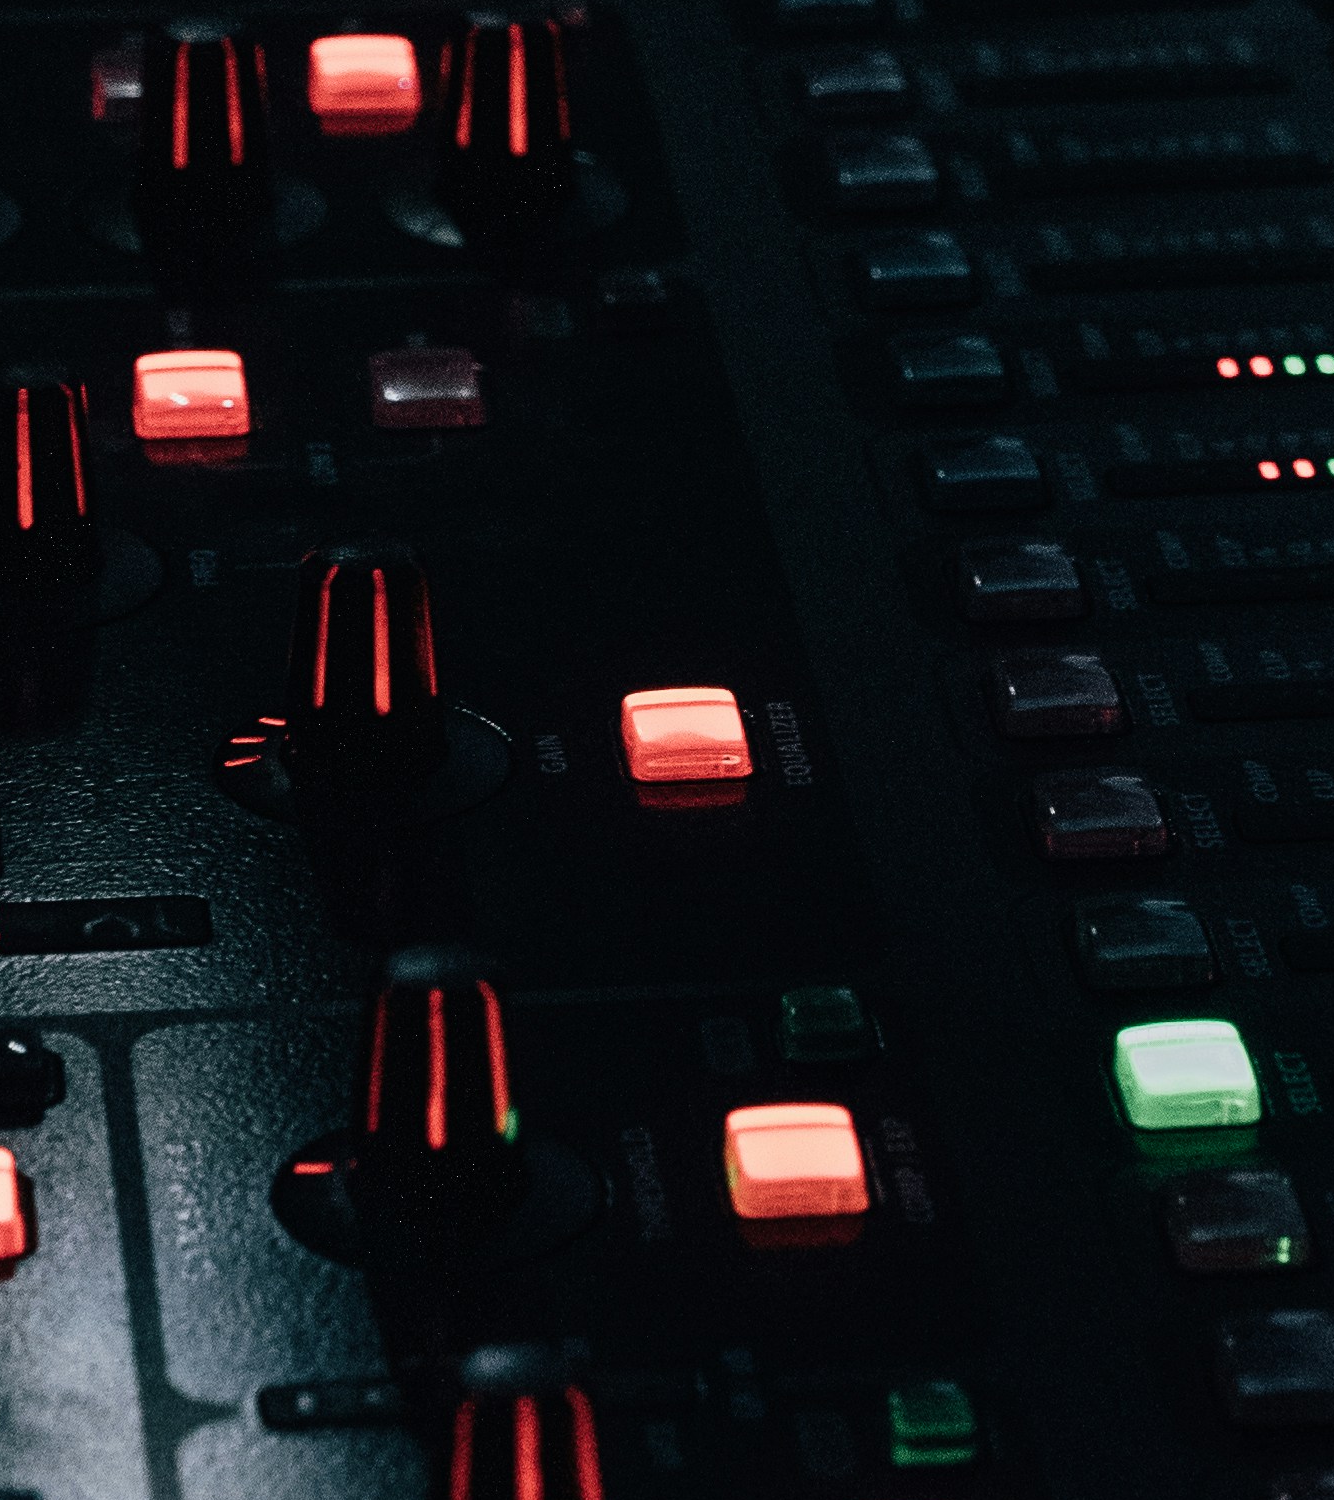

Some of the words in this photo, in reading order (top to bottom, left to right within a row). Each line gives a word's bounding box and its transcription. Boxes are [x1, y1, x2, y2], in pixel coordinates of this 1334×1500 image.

[1094, 556, 1139, 610] SELECT
[1198, 638, 1235, 682] COMP
[1259, 648, 1292, 679] CLIP
[1136, 671, 1180, 726] SELECT
[533, 732, 568, 774] GAIN
[767, 700, 815, 785] EQUALIZER
[1242, 758, 1282, 803] COMP
[1180, 790, 1226, 849] SELECT
[1290, 882, 1331, 928] COMP
[1225, 915, 1274, 977] SELECT
[1274, 1049, 1324, 1114] SELECT
